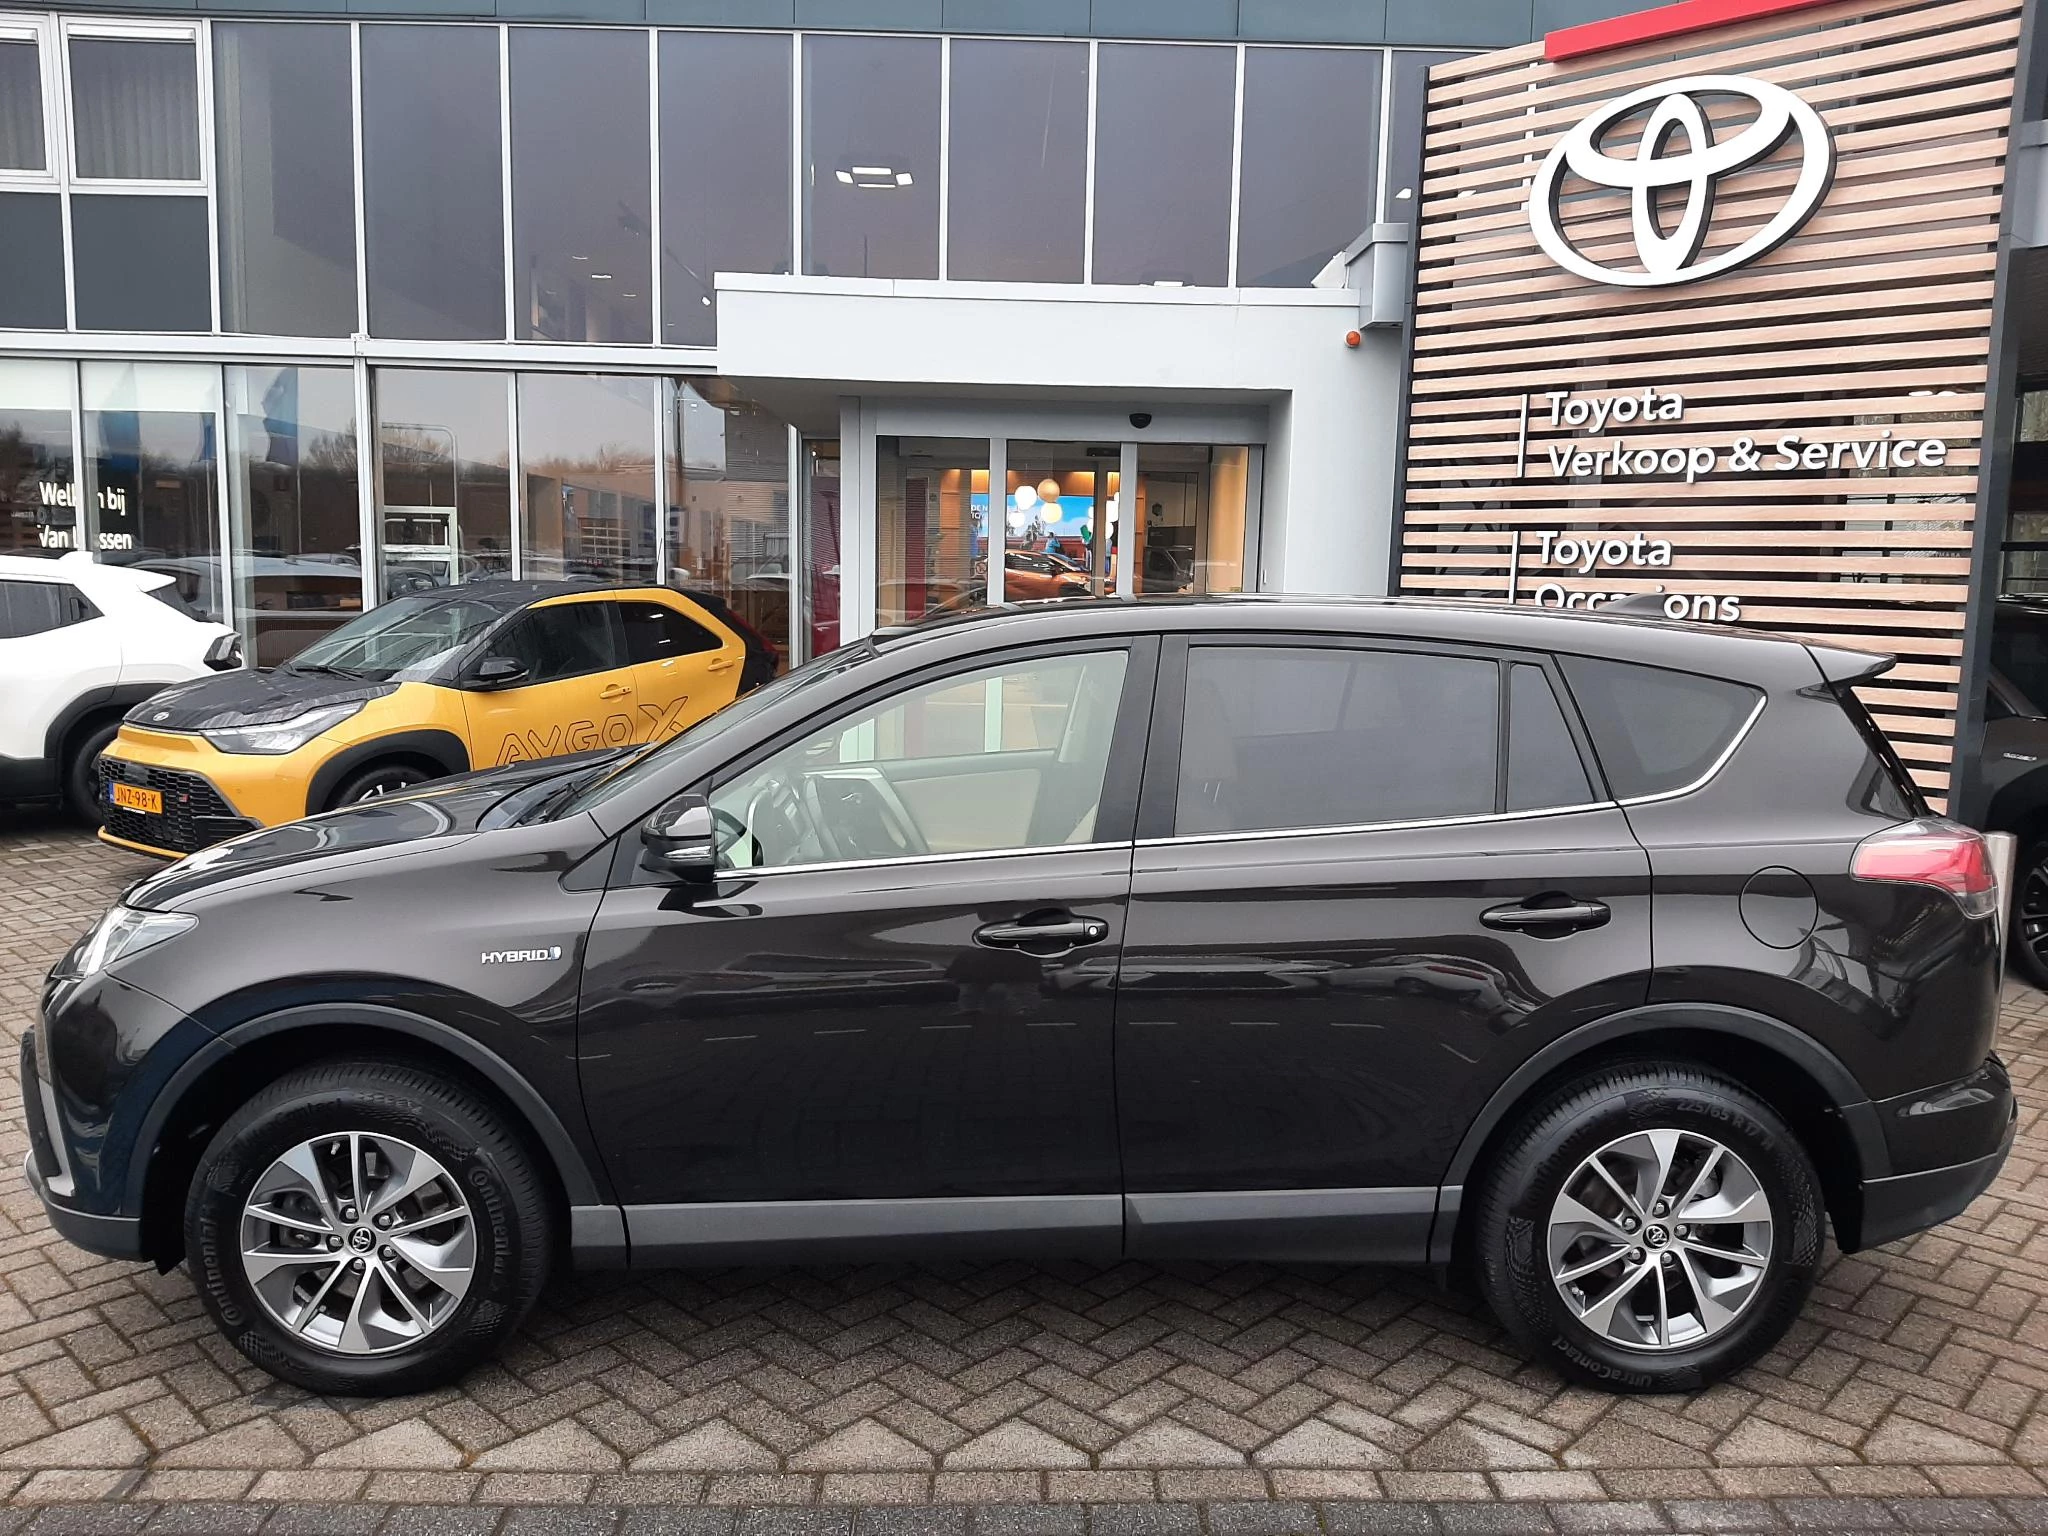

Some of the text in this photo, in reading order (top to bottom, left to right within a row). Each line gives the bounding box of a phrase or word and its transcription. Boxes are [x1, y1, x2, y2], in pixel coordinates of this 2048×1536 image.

[1547, 388, 1685, 432] Toyota
[1548, 430, 1947, 484] Verkoop & Service
[39, 481, 126, 516] Wel bij
[37, 525, 132, 550] Van Lssen
[1536, 531, 1672, 573] Toyota
[1534, 582, 1740, 622] Occons
[116, 786, 158, 811] JNZ-98-K
[481, 949, 549, 964] HYBRID
[1551, 1333, 1653, 1388] UltraContact
